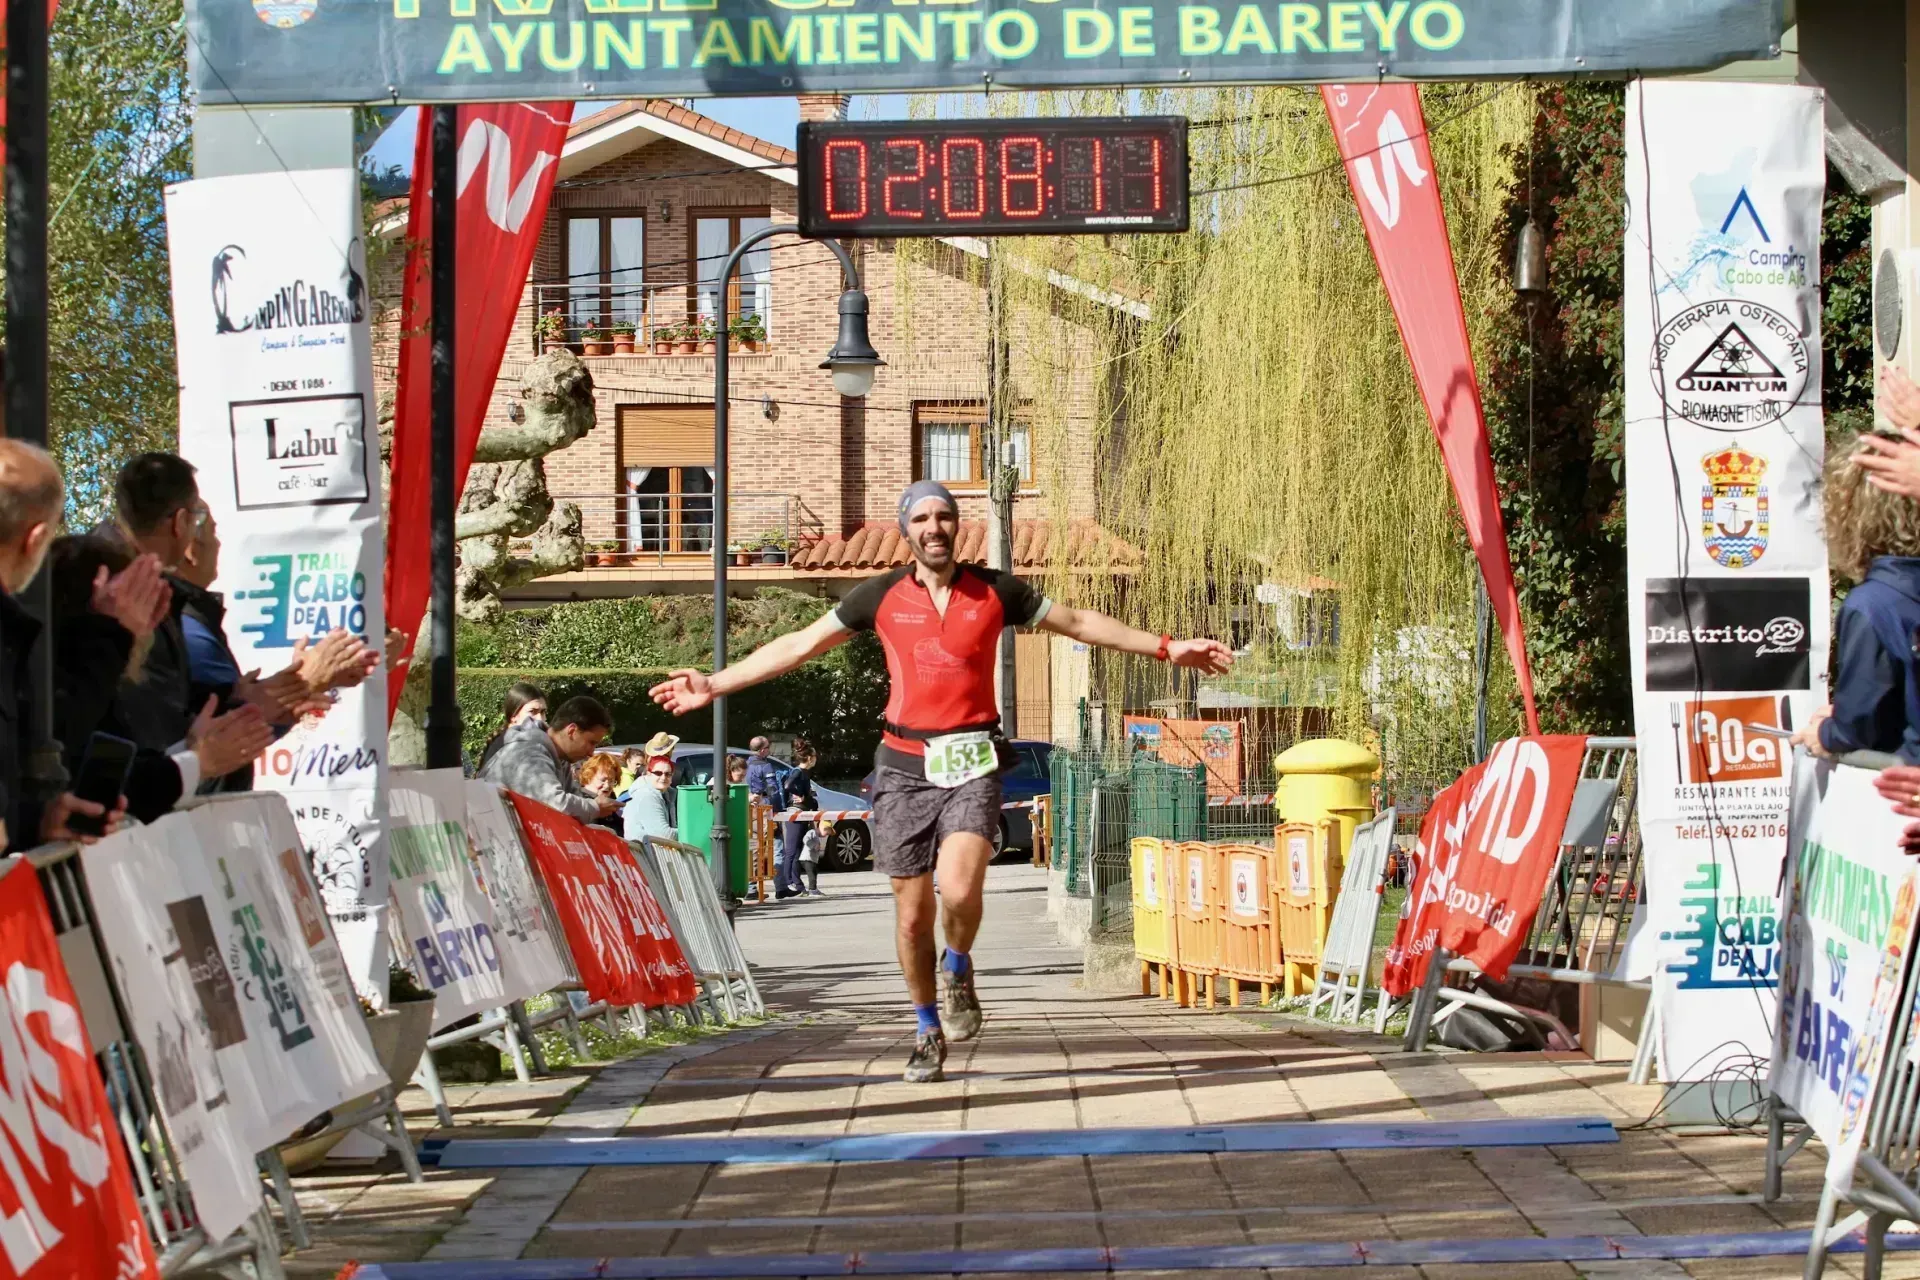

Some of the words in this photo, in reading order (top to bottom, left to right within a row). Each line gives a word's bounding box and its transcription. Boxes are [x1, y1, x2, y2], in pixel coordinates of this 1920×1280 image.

[436, 9, 1039, 74] AYUNTAMIENTO
[1062, 7, 1156, 59] DE
[1178, 0, 1465, 56] BAREYO
[823, 136, 1162, 220] 02:08:11
[1749, 245, 1806, 271] Camping
[1725, 268, 1763, 285] Cabo
[1767, 267, 1785, 285] de
[1740, 304, 1808, 374] OSTEOPATIA
[1675, 378, 1788, 393] QUANTUM
[1681, 399, 1782, 423] BIOMAGNETISMO
[263, 417, 339, 461] Labu
[297, 553, 348, 571] TRAIL
[293, 572, 366, 604] CABO
[293, 607, 316, 626] DE
[1648, 625, 1764, 644] Distrito
[289, 744, 380, 787] Miera
[1725, 761, 1776, 772] RESTAURANTE
[1674, 786, 1758, 799] RESTAURANTE
[312, 806, 331, 820] DE
[1726, 802, 1753, 811] PLAYA
[1754, 802, 1766, 811] DE
[1727, 812, 1779, 820] INFINITO
[1715, 825, 1739, 839] 942
[1741, 824, 1758, 838] 62
[1761, 824, 1776, 838] 10
[1778, 824, 1789, 837] 6
[1723, 895, 1776, 914] TRAIL
